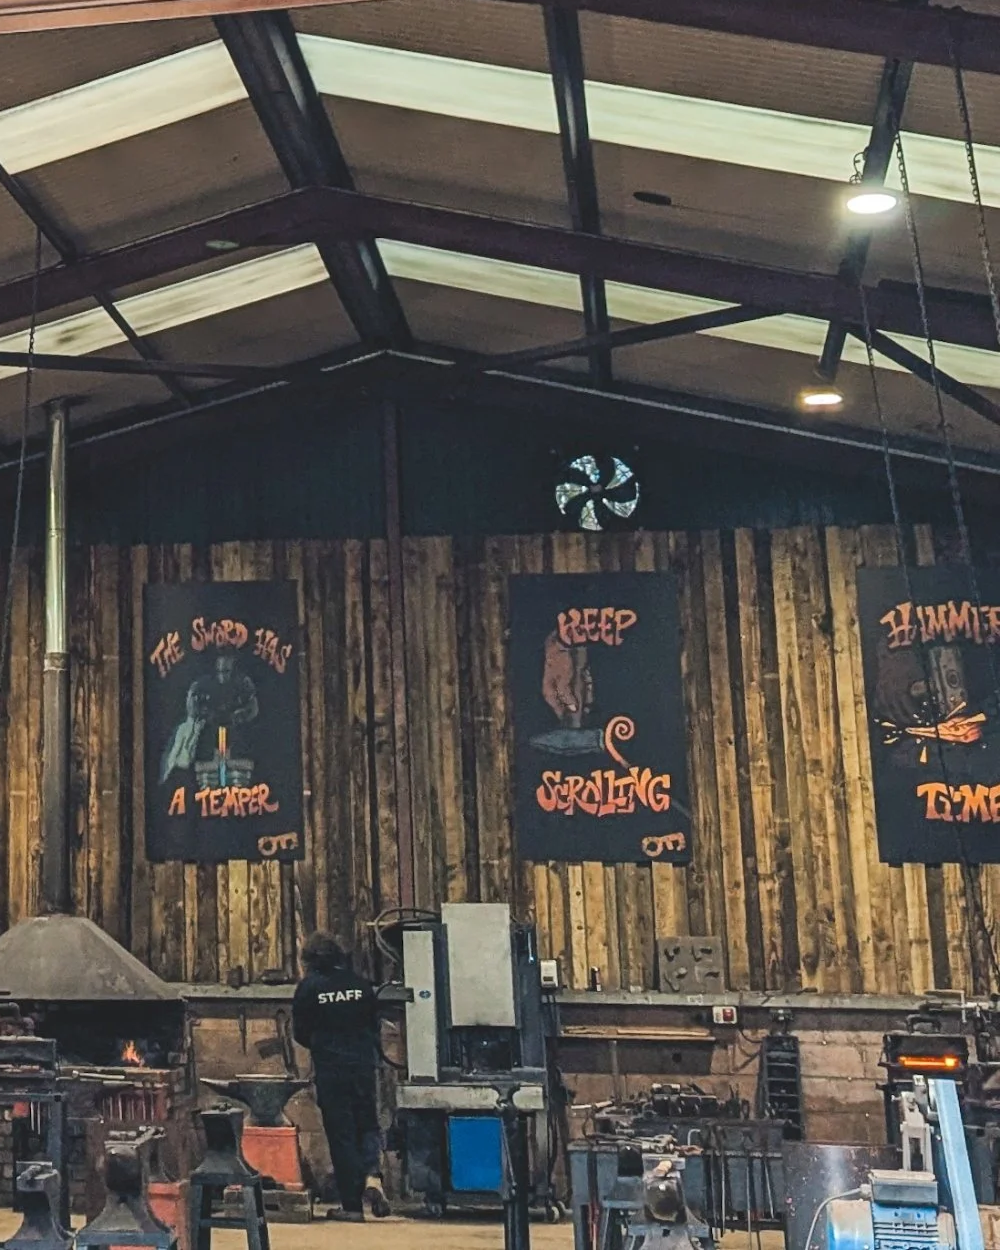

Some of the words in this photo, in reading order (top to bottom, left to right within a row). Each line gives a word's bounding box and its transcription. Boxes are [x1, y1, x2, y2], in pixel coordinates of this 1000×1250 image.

[557, 607, 638, 646] KEEP
[150, 631, 185, 678] THE
[191, 617, 248, 651] SWORD
[253, 628, 292, 673] HAS
[168, 786, 186, 816] A
[195, 783, 279, 817] TEMPER
[536, 767, 671, 817] SCROLLING
[318, 989, 363, 1004] STAFF
